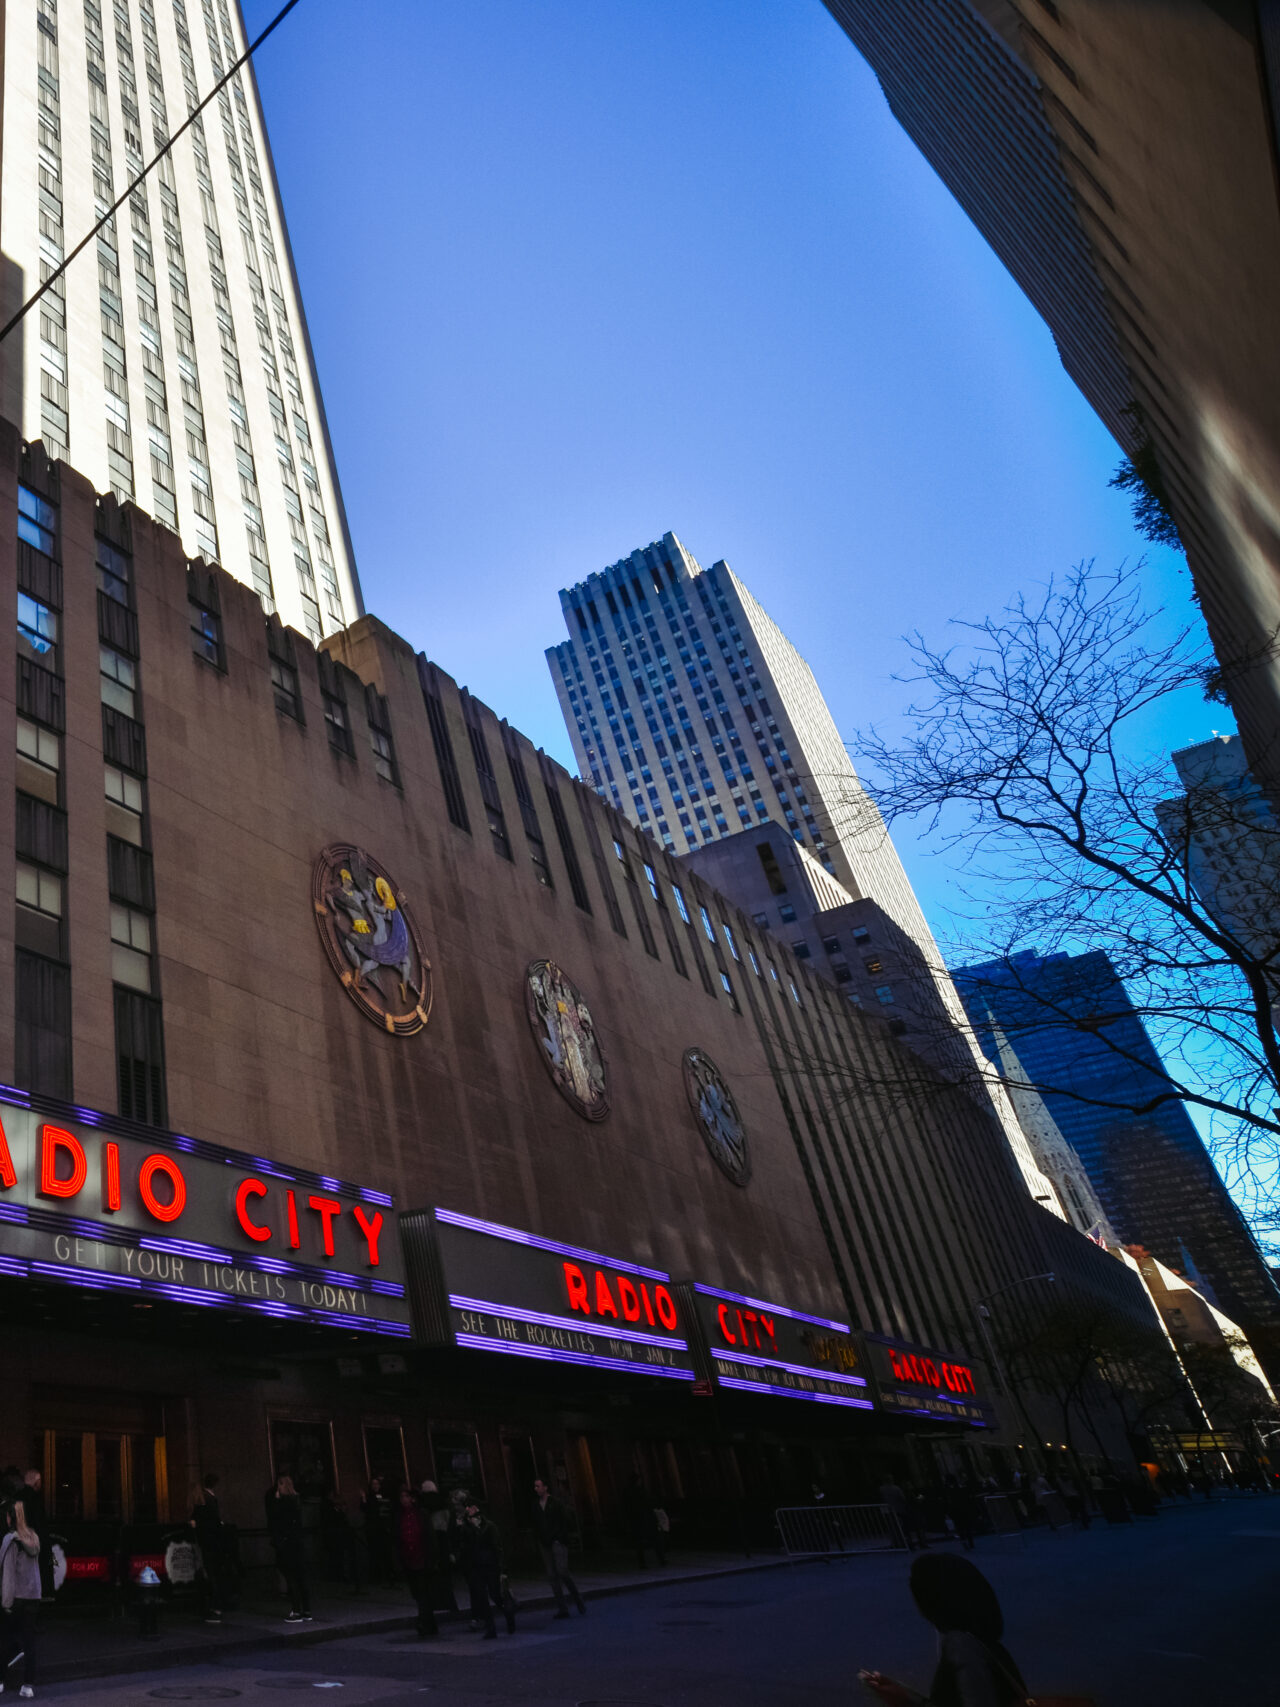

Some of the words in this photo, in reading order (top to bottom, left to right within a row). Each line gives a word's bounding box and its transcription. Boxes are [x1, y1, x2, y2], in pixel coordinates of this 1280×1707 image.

[236, 1177, 385, 1266] CITY
[54, 1234, 105, 1266] GET
[123, 1248, 185, 1282] YOUR
[200, 1262, 286, 1300] TICKETS
[299, 1280, 368, 1314] TODAY!
[562, 1262, 678, 1331] RADIO
[717, 1303, 779, 1353] CITY
[461, 1311, 488, 1335] SEE
[494, 1317, 520, 1341] THE
[526, 1323, 596, 1353] ROCKETTES
[609, 1339, 634, 1359] NOW
[646, 1347, 666, 1364] JAN
[888, 1348, 940, 1389] RADIO
[941, 1361, 977, 1396] CITY
